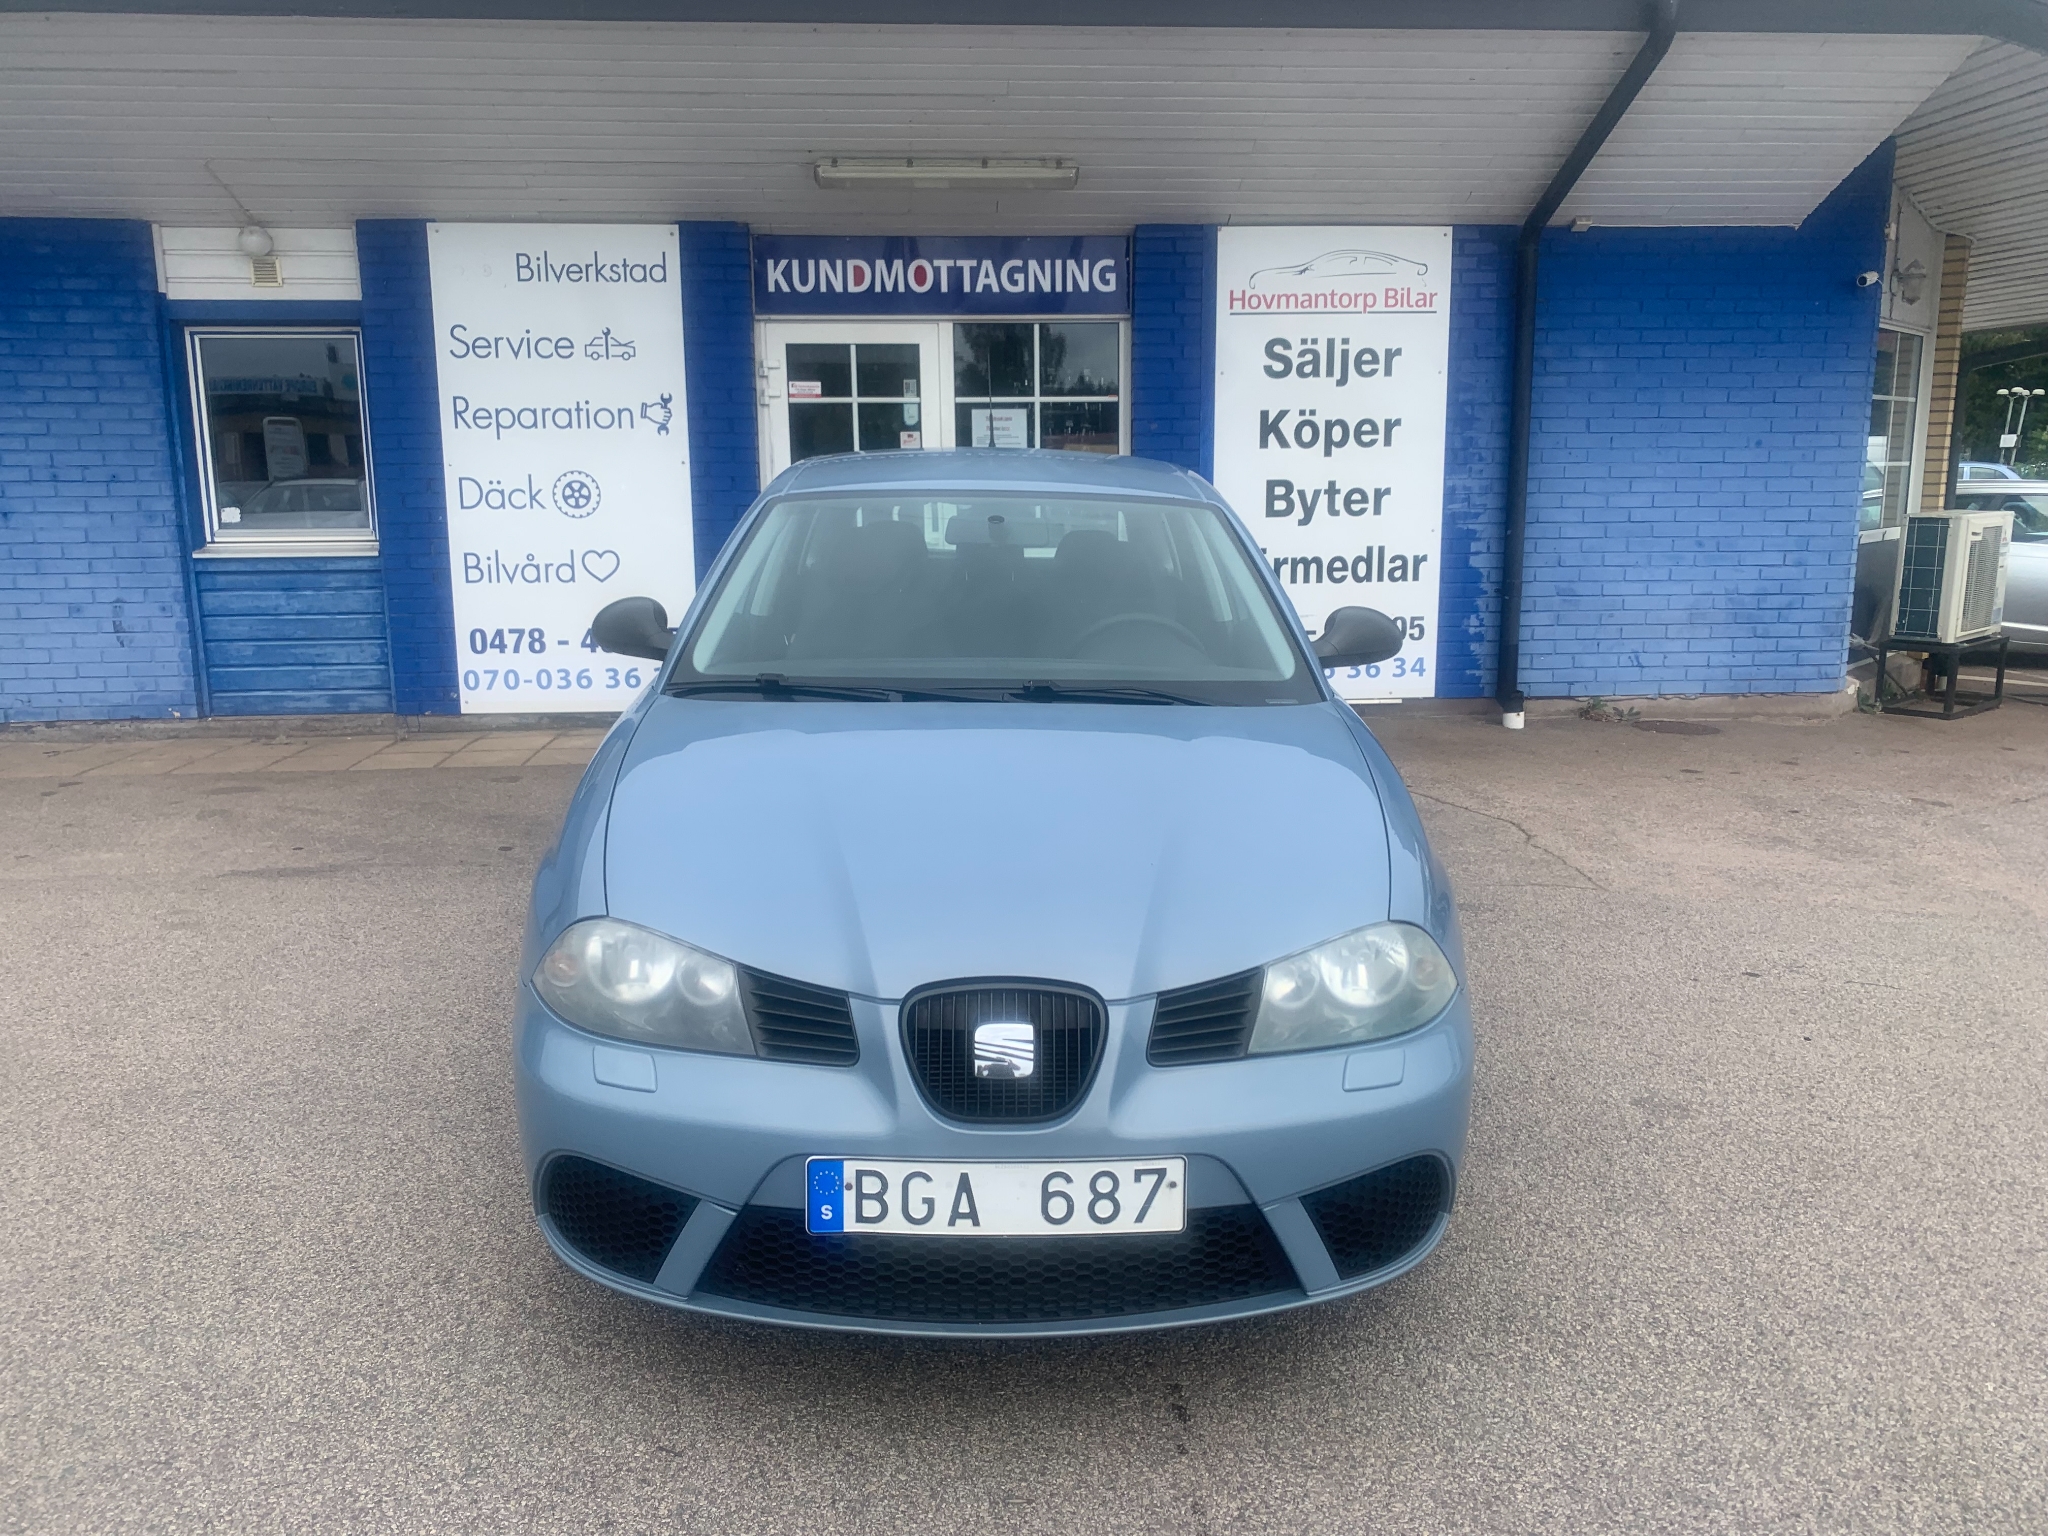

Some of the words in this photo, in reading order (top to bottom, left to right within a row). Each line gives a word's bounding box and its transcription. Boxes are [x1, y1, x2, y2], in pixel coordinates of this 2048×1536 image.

[515, 250, 667, 283] Bilverkstad
[767, 258, 1117, 293] KUNDMOTTAGNING
[1229, 289, 1377, 314] Hovmantorp
[1384, 287, 1438, 308] Bilar
[449, 324, 575, 359] Service
[1263, 337, 1402, 387] Säljer
[452, 395, 635, 440] Reparation
[1259, 408, 1402, 457] Köper
[458, 474, 546, 510] Däck
[1265, 479, 1391, 526] Byter
[463, 549, 576, 584] Bilvård
[1261, 545, 1428, 584] rmedlar
[469, 628, 546, 654] 0478
[463, 669, 593, 691] 070-036
[605, 667, 641, 689] 36
[1392, 656, 1426, 678] 34
[820, 1204, 833, 1220] S
[854, 1168, 981, 1227] BGA
[1040, 1167, 1168, 1226] 687
